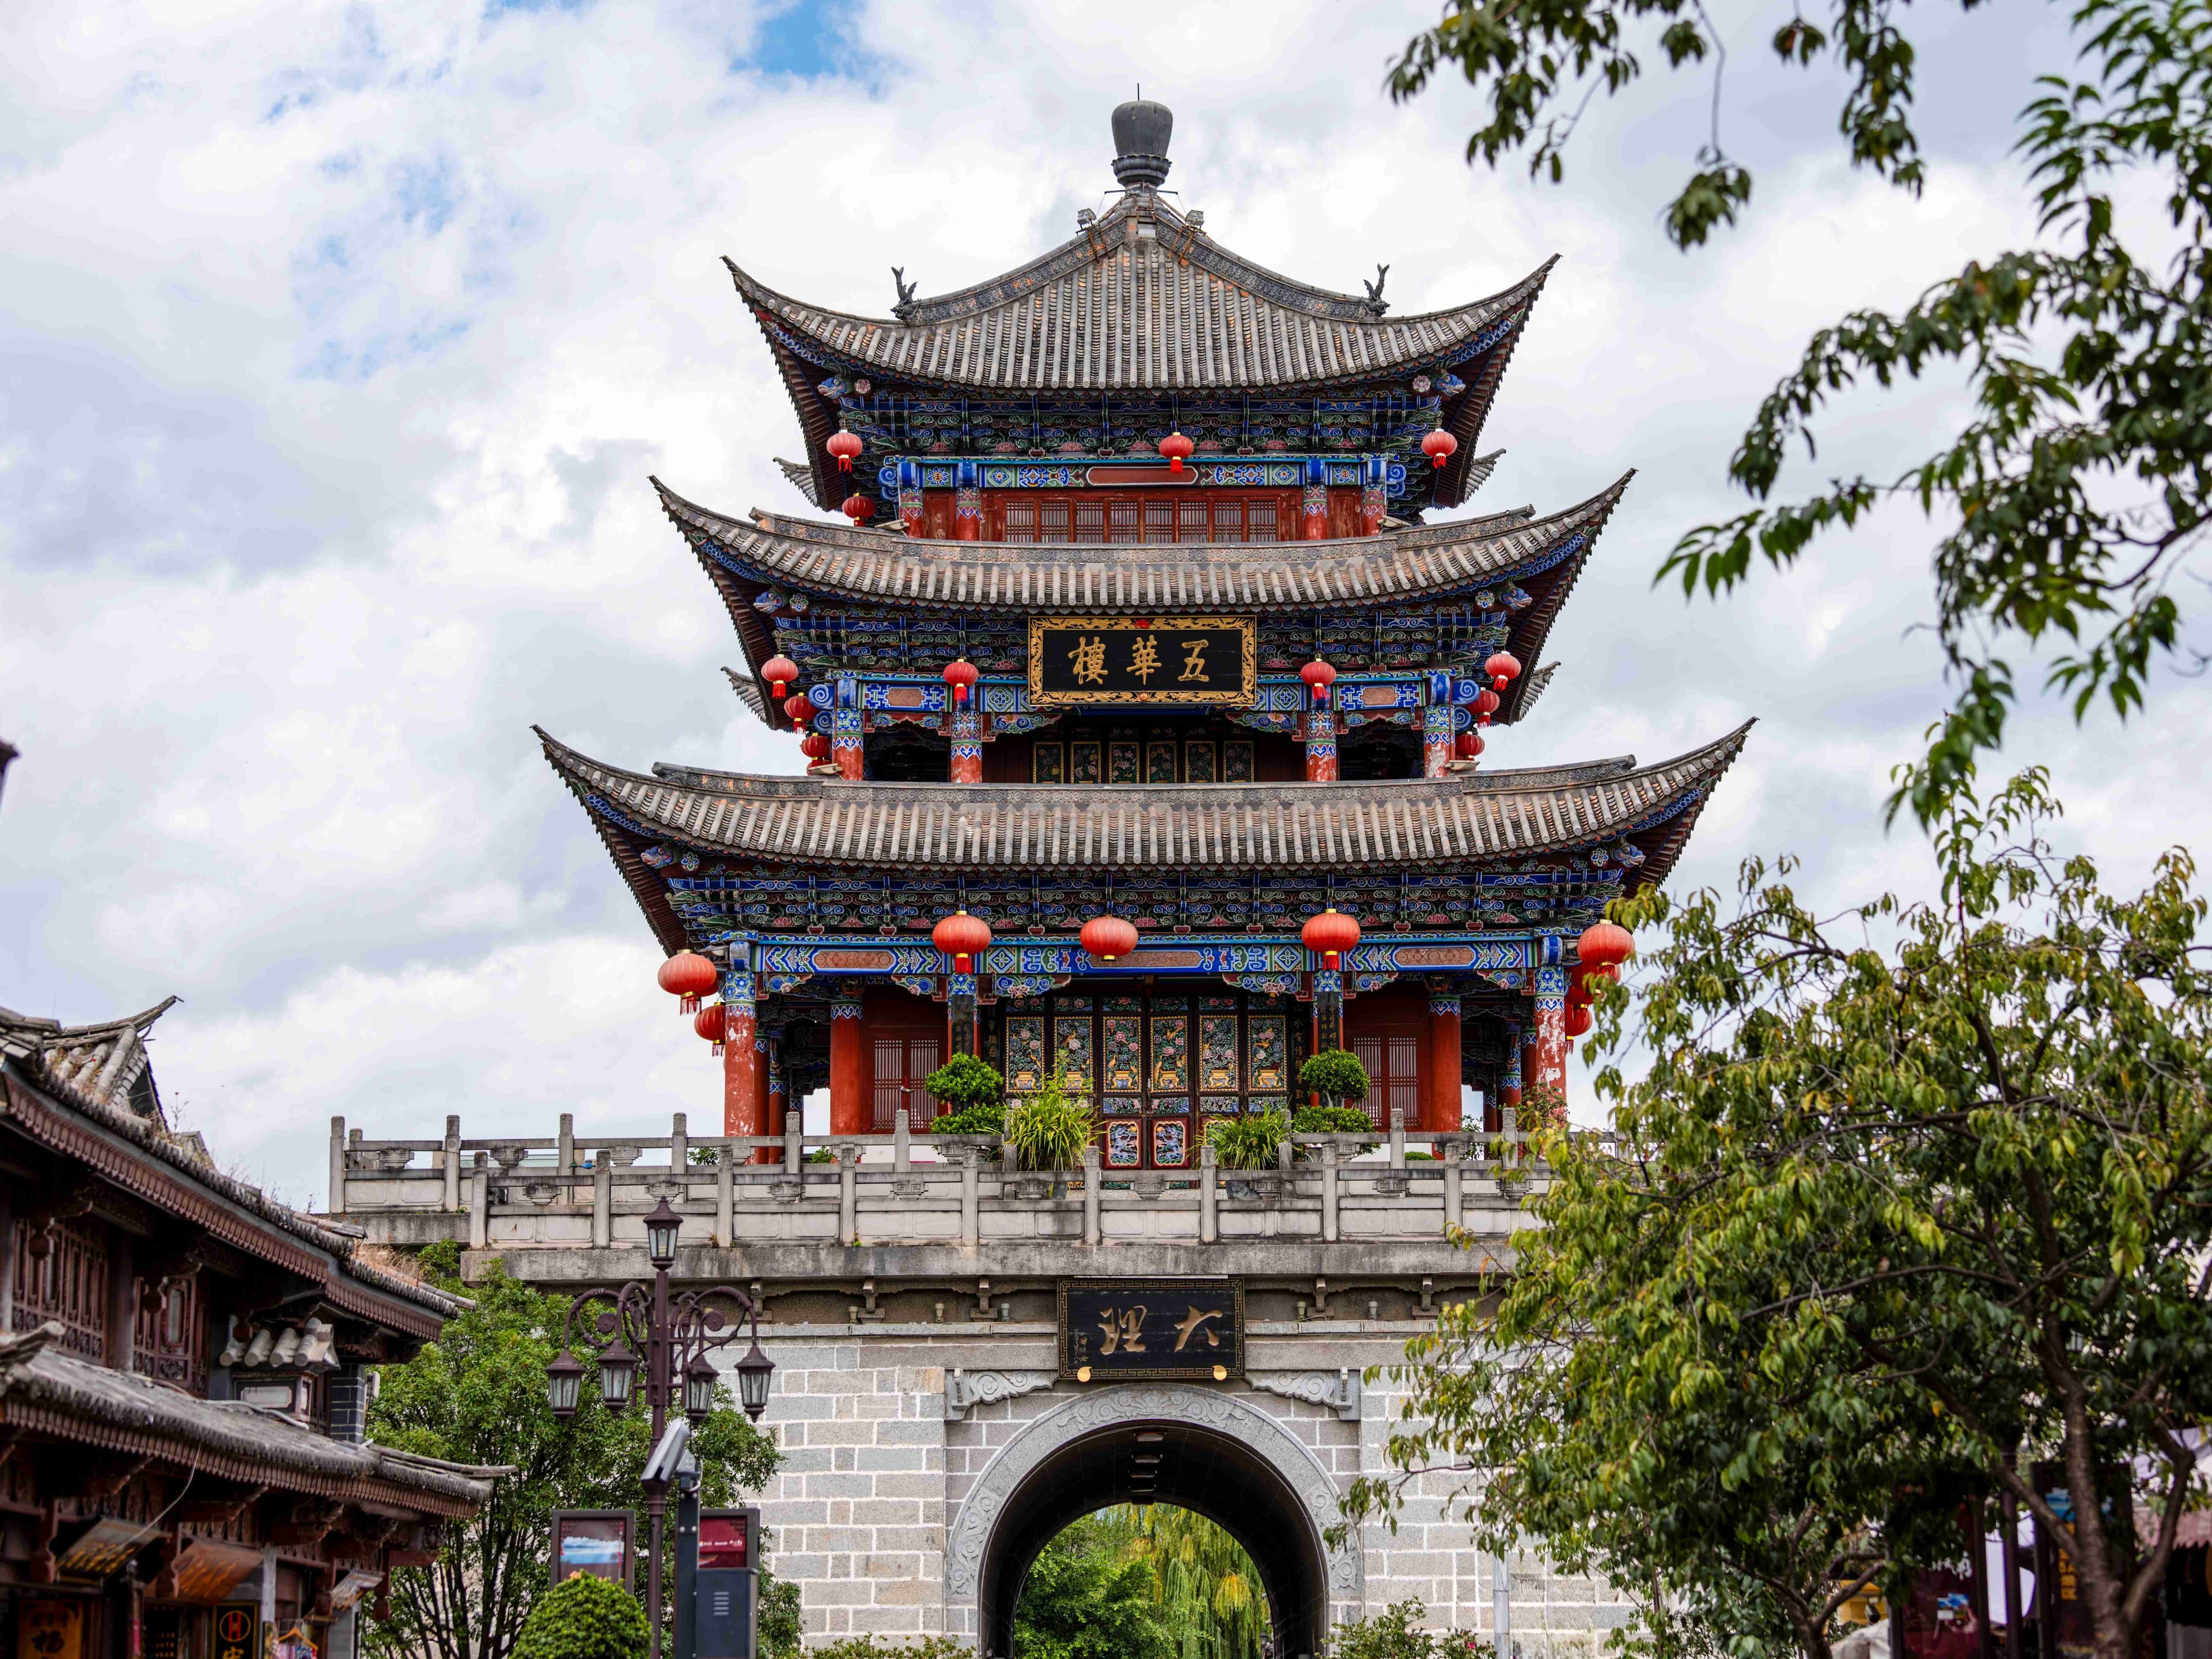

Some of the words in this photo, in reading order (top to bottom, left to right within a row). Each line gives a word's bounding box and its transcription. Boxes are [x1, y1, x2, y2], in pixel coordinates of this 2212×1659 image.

[1067, 635, 1210, 685] 五華樓
[1098, 1305, 1223, 1355] 大理
